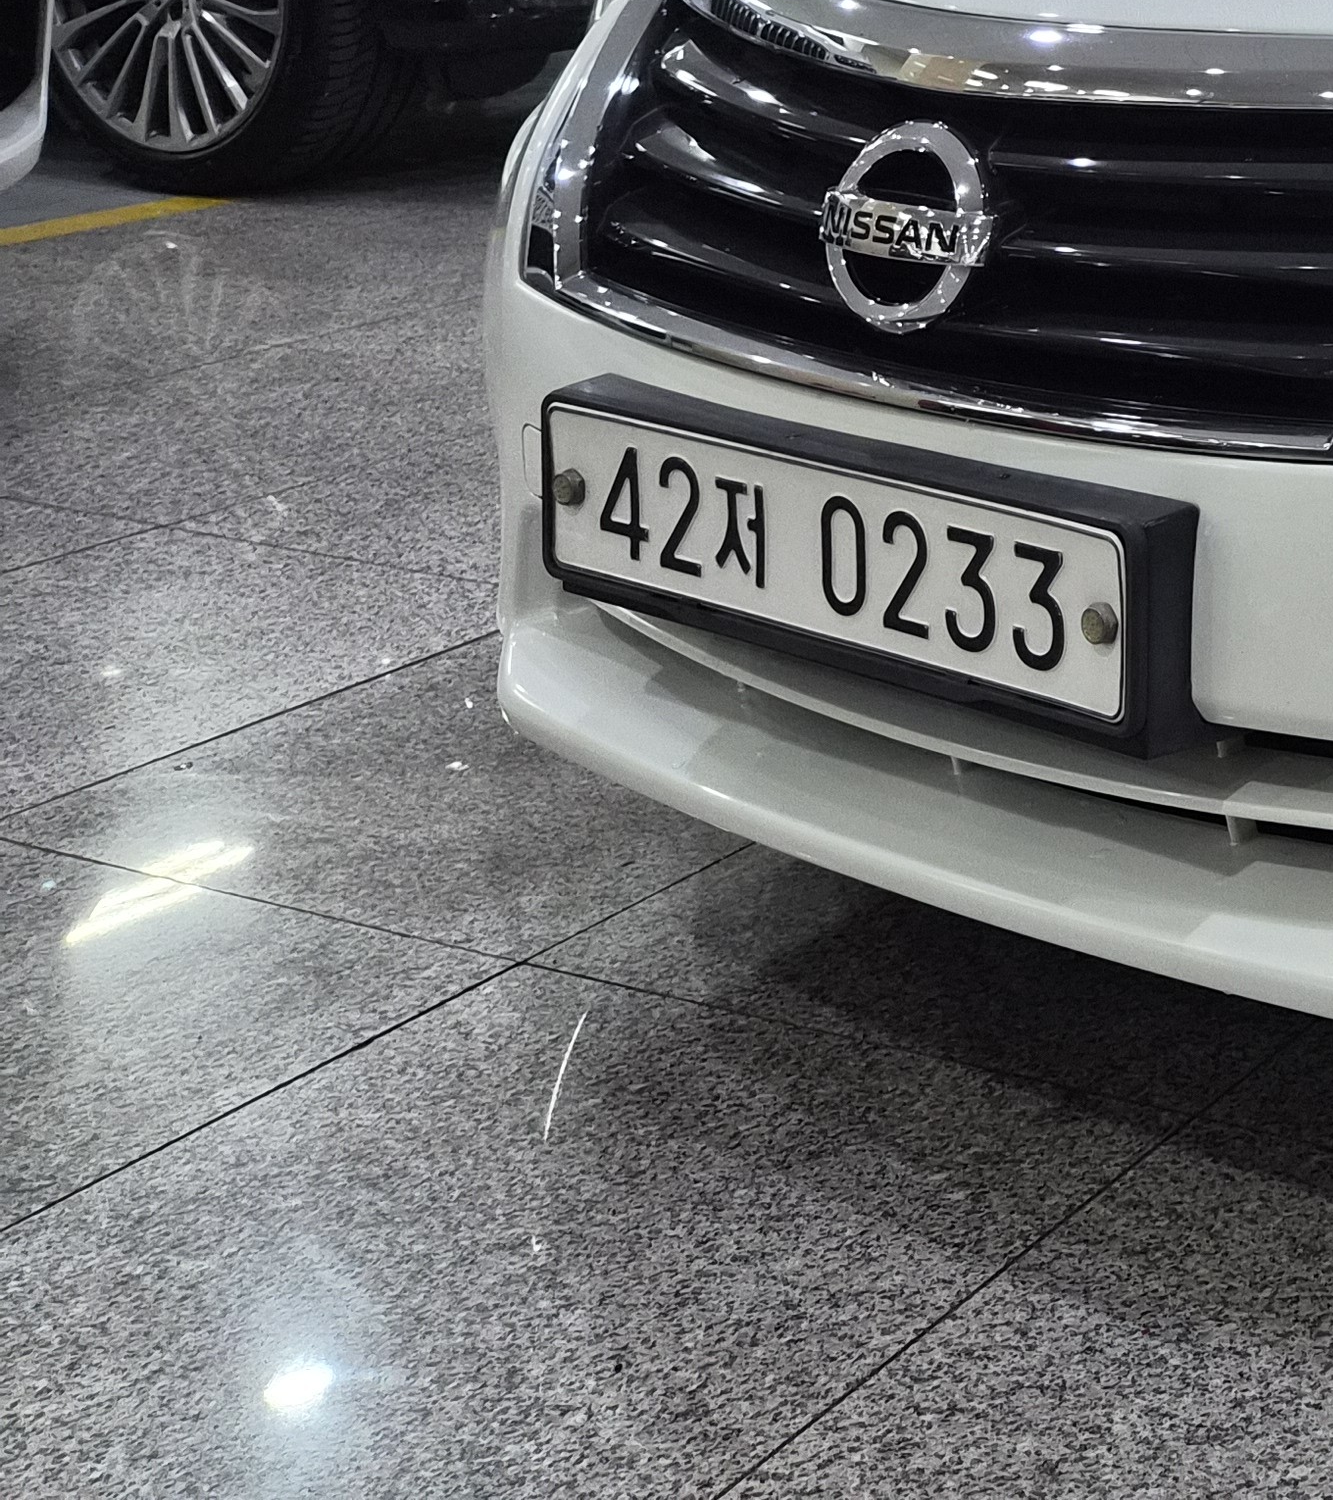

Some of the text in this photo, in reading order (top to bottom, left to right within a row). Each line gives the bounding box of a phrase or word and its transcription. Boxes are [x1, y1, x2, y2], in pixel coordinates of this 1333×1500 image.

[822, 201, 961, 254] NISSAN
[599, 445, 1065, 673] 42저 0233
